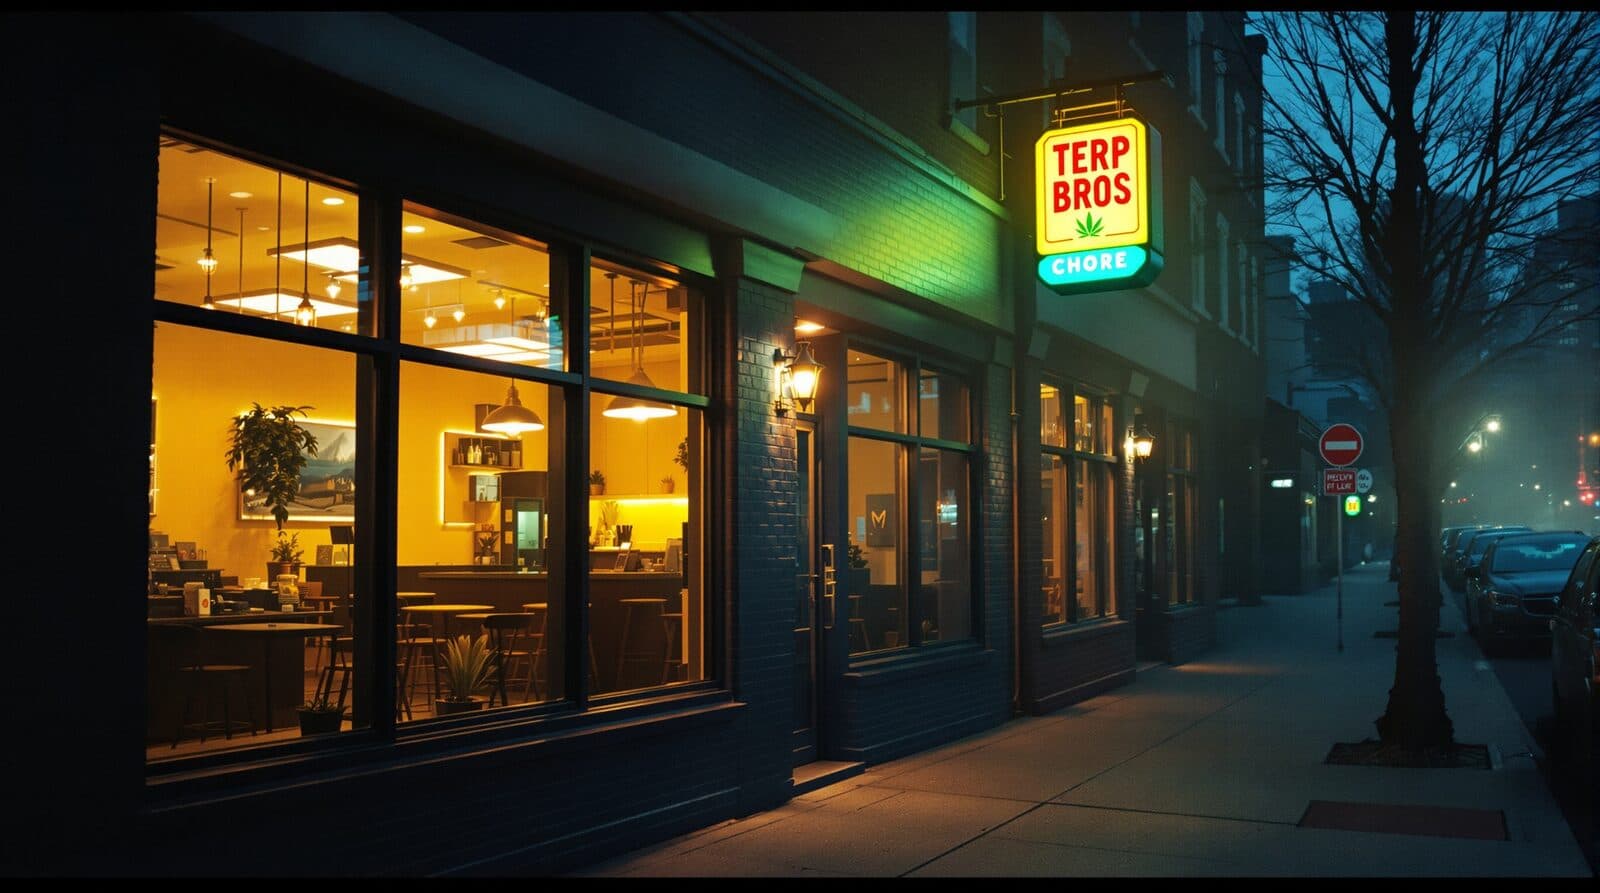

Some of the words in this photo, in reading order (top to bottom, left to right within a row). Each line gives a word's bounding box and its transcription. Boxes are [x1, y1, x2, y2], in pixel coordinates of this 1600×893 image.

[1053, 136, 1130, 176] TERP
[1053, 172, 1132, 213] BROS
[1052, 251, 1128, 275] CHORE
[871, 510, 887, 528] M
